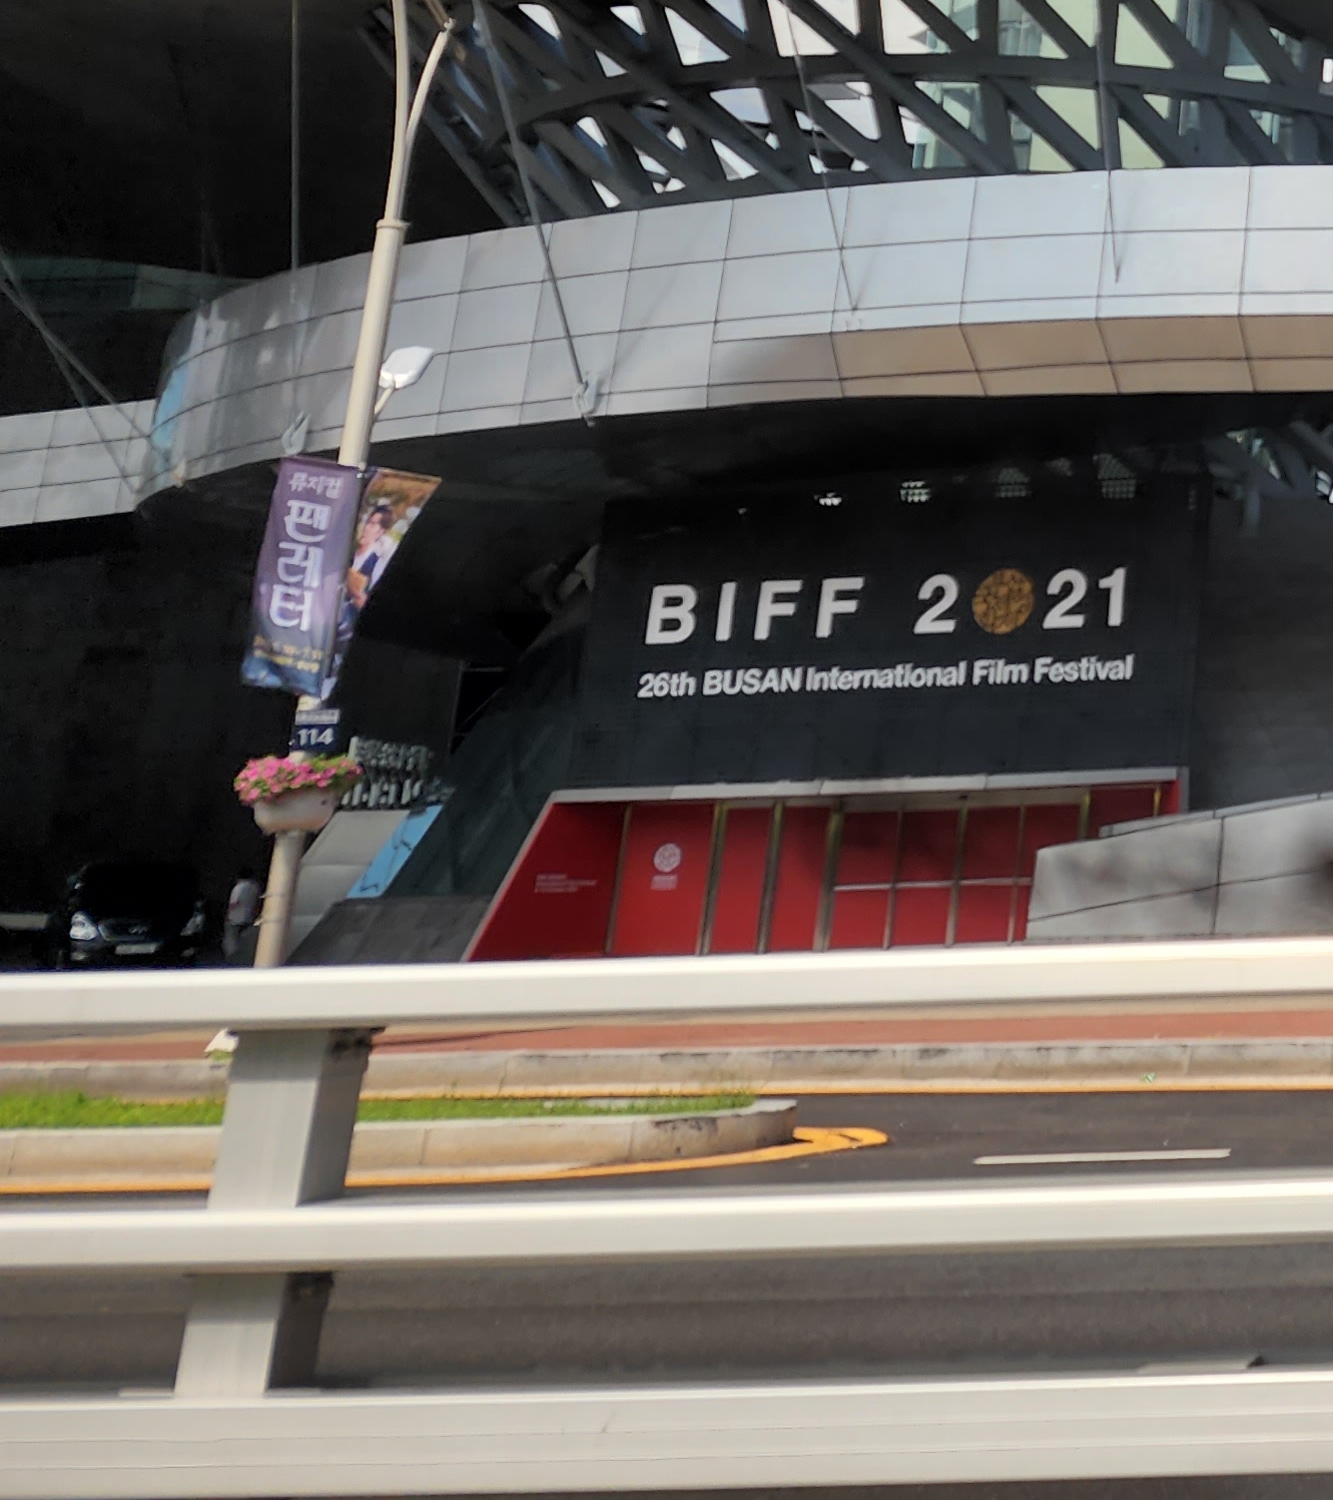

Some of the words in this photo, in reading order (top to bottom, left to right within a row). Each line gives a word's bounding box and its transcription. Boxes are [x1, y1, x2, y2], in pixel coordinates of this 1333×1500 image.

[268, 499, 332, 632] 팬레터
[644, 576, 866, 645] BIFF
[637, 671, 697, 698] 26th
[702, 666, 803, 696] BUSAN
[805, 660, 967, 692] International
[972, 658, 1030, 686] Film
[1033, 653, 1136, 684] Festival
[297, 727, 334, 746] 114
